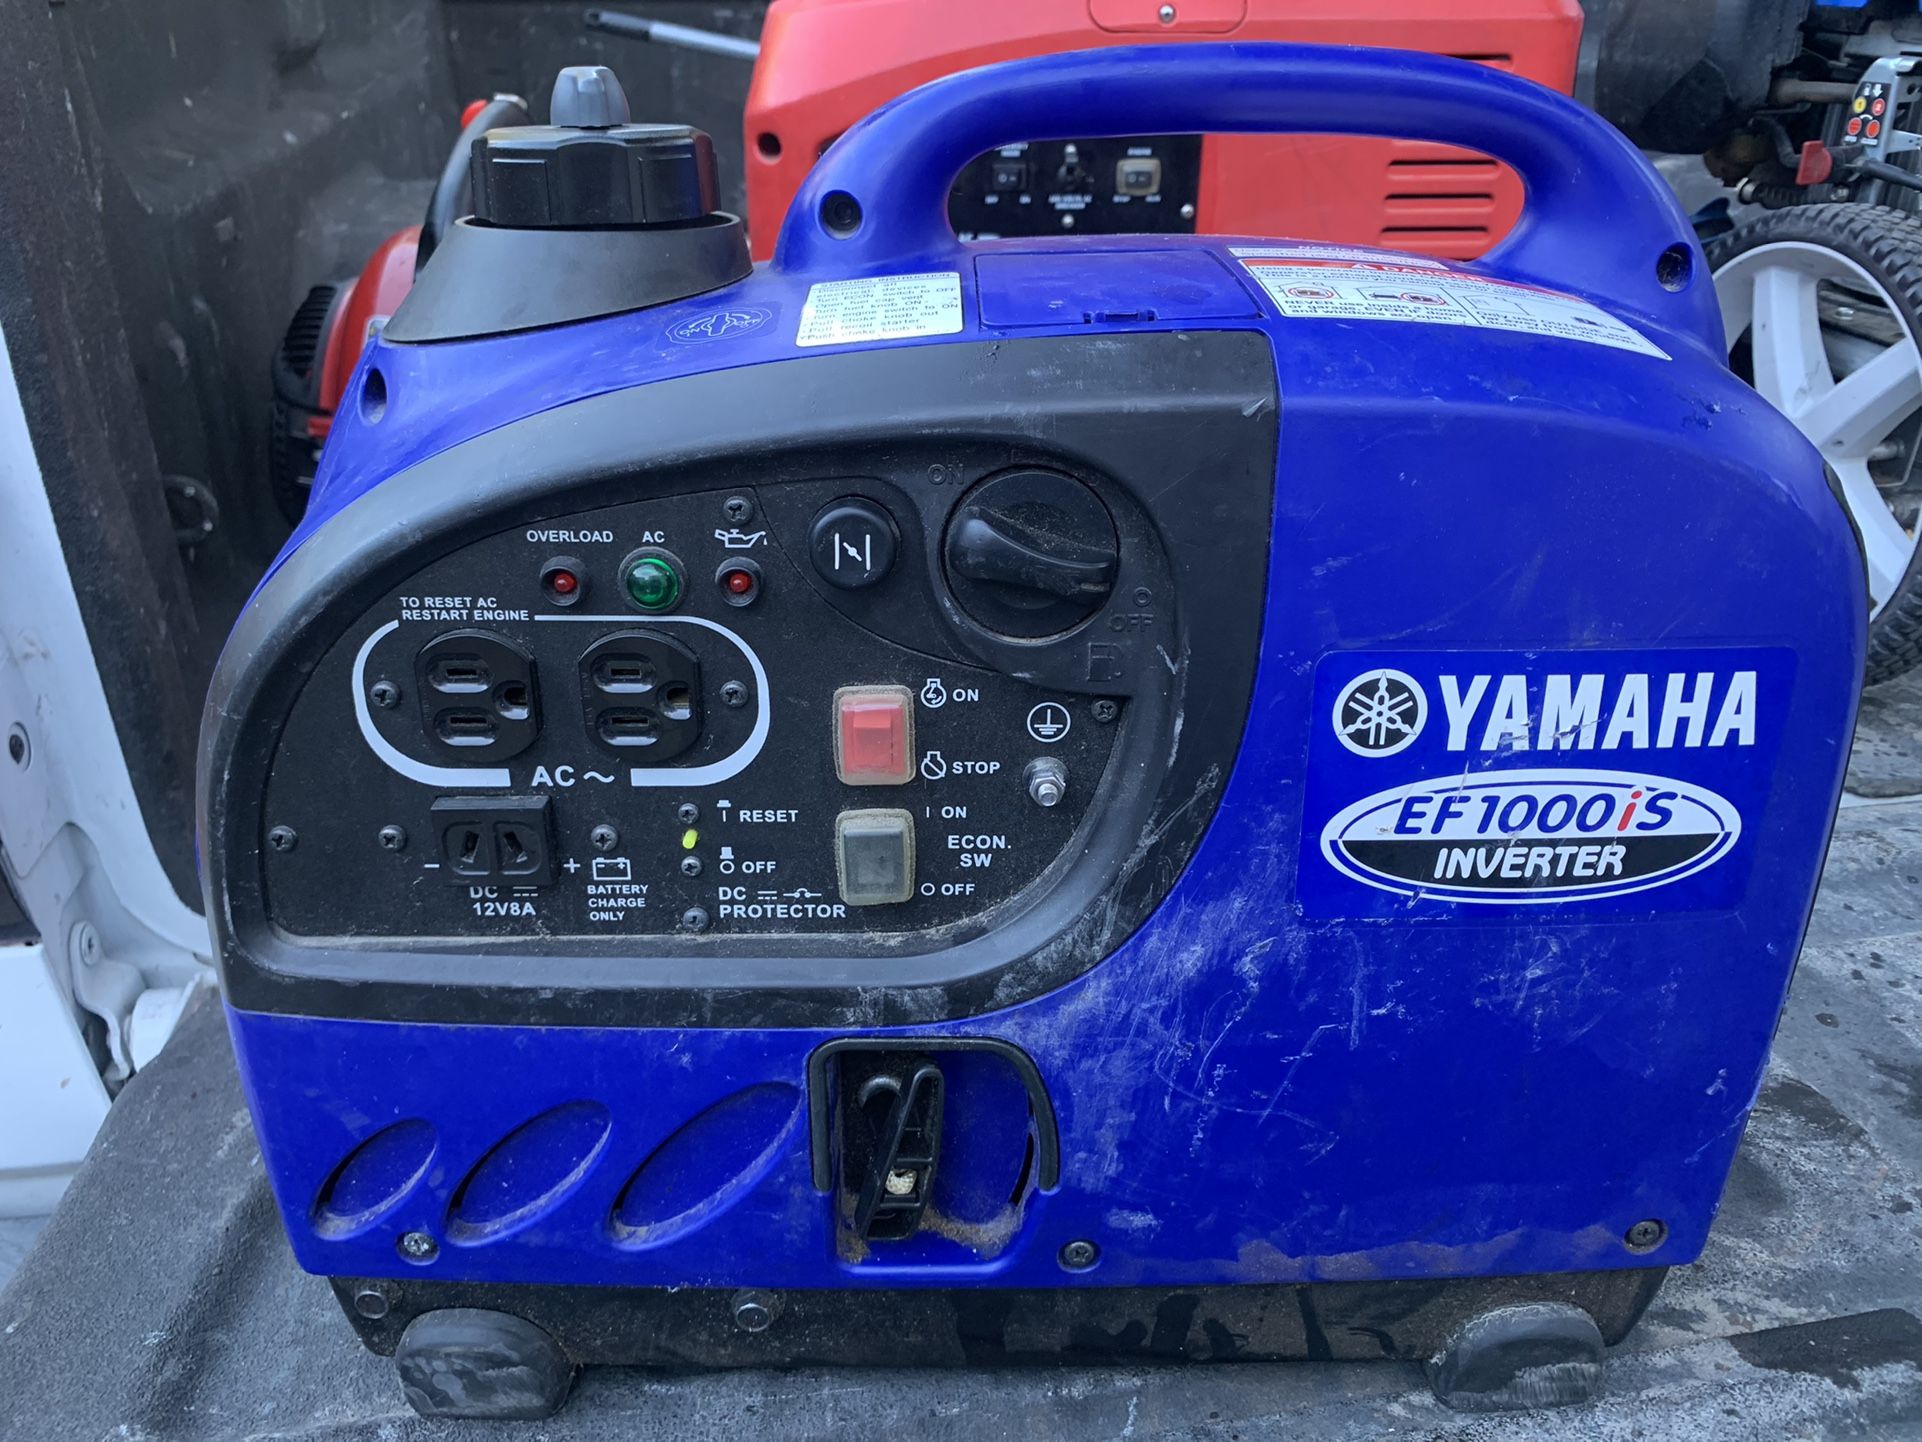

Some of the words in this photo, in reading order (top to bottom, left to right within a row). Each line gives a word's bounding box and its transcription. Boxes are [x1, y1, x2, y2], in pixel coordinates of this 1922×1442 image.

[927, 464, 964, 486] ON
[527, 530, 613, 543] OVERLOAD
[642, 530, 665, 543] AC
[400, 597, 420, 608] TO
[424, 597, 473, 608] RESET
[477, 597, 497, 608] AC
[402, 609, 469, 621] RESTART
[474, 609, 530, 621] ENGINE
[1108, 614, 1153, 632] OFF
[952, 688, 979, 702] ON
[1438, 671, 1757, 752] YAMAHA
[952, 761, 1000, 774] STOP
[531, 765, 576, 787] AC
[739, 809, 798, 822] RESET
[941, 806, 967, 819] ON
[1394, 789, 1679, 835] EF1000iS
[948, 835, 1012, 849] ECON.
[960, 854, 992, 867] SW
[1434, 844, 1627, 880] INVERTER
[741, 861, 777, 874] OFF
[470, 887, 498, 899] DC
[587, 884, 649, 895] BATTERY
[719, 886, 747, 900] DC
[941, 883, 976, 896] OFF
[472, 902, 536, 916] 12V8A
[588, 897, 646, 908] CHARGE
[590, 911, 625, 921] ONLY
[719, 904, 846, 919] PROTECTOR
